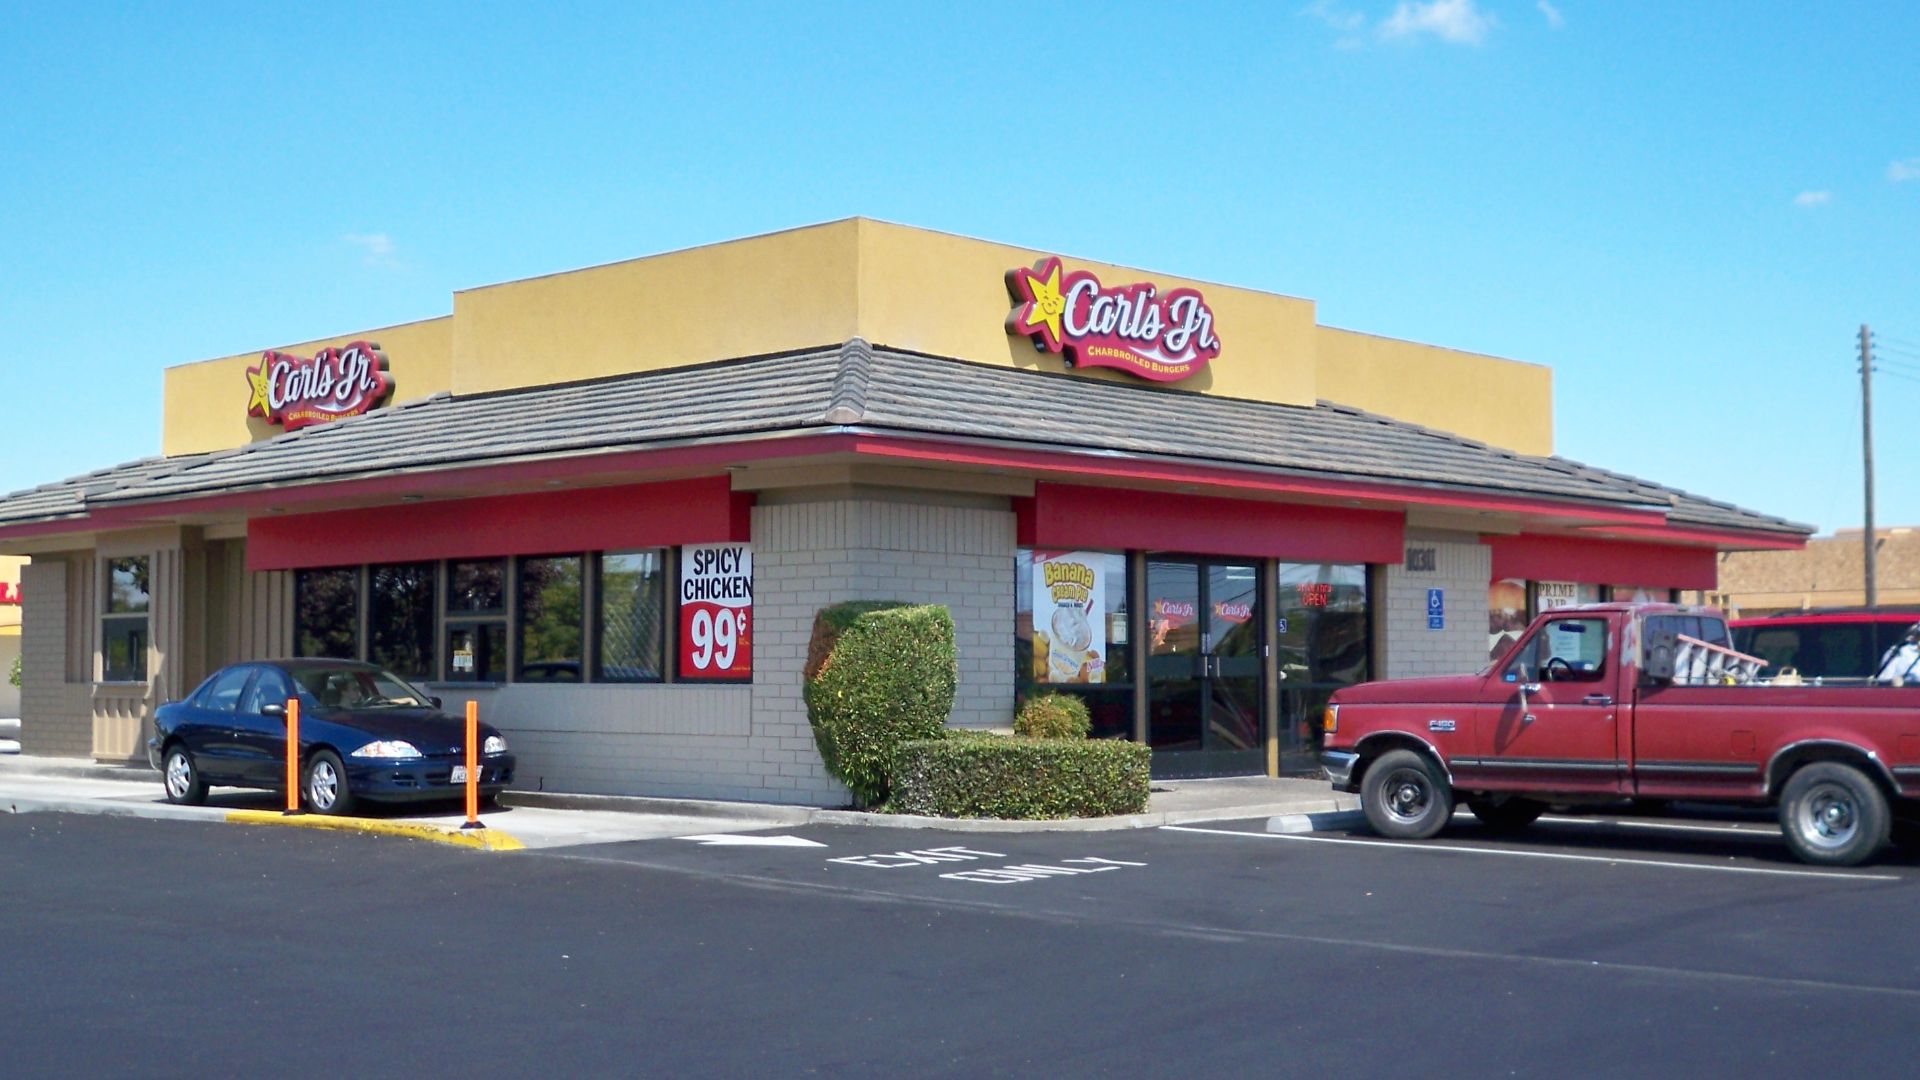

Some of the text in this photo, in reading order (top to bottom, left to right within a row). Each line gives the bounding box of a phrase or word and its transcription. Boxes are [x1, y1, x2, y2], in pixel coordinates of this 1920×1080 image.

[1063, 279, 1220, 352] Carl's Jr.
[1087, 345, 1190, 374] CHARBROILED BURGERS
[268, 348, 377, 409] Carl's Jr.
[693, 547, 743, 576] SPICY
[1043, 561, 1095, 590] Banana
[683, 576, 753, 600] CHICKEN
[1303, 593, 1327, 606] OPEN
[1539, 583, 1576, 597] PRIME
[826, 846, 1007, 868] EXIT
[939, 856, 1148, 884] ONLY
